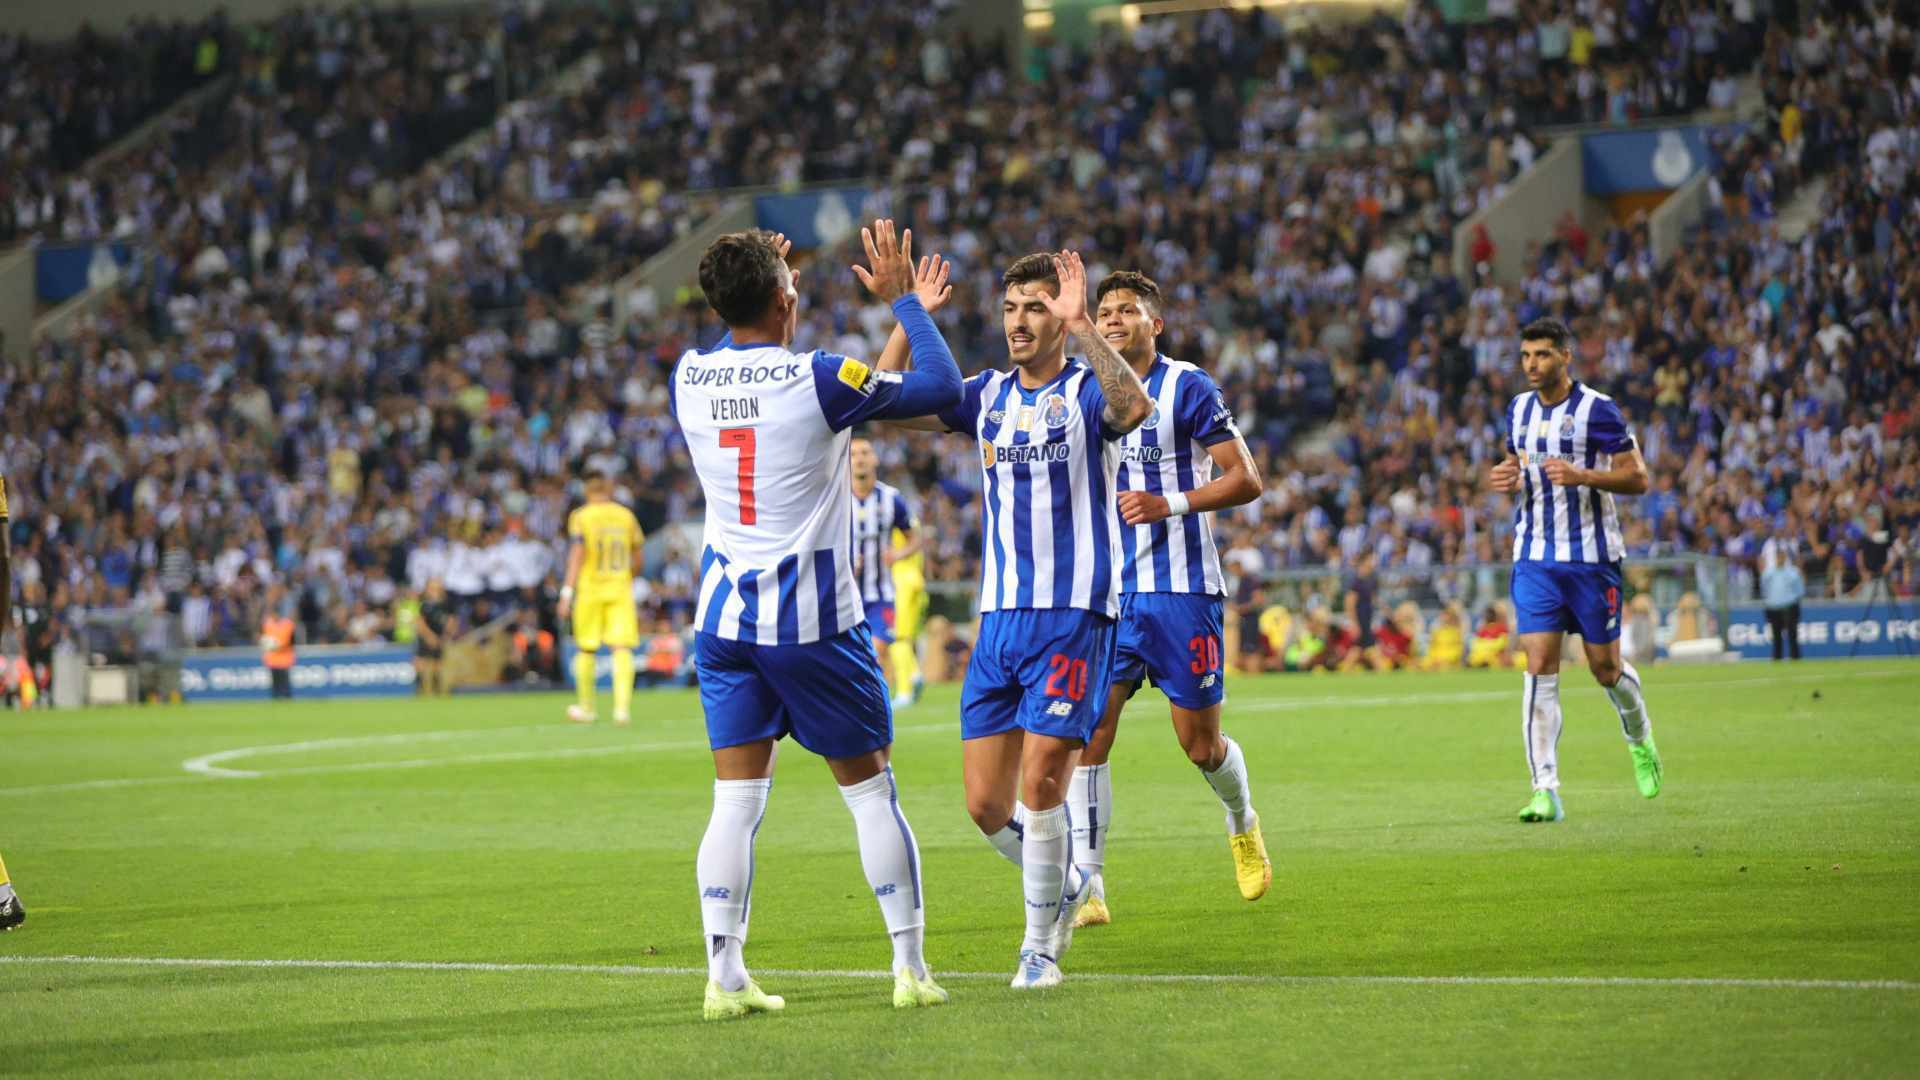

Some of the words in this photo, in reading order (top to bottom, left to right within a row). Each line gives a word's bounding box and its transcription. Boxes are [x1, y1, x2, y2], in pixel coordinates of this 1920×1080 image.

[684, 365, 732, 387] SUPER
[738, 364, 801, 384] BOCK
[711, 397, 760, 421] VERON
[996, 442, 1071, 463] BETANO
[1119, 446, 1163, 462] TANO
[718, 427, 757, 526] 7
[1727, 621, 1829, 645] CLE
[1834, 620, 1881, 643] DO
[1188, 634, 1220, 674] 30
[208, 666, 272, 691] CLUB
[1044, 653, 1088, 701] 20
